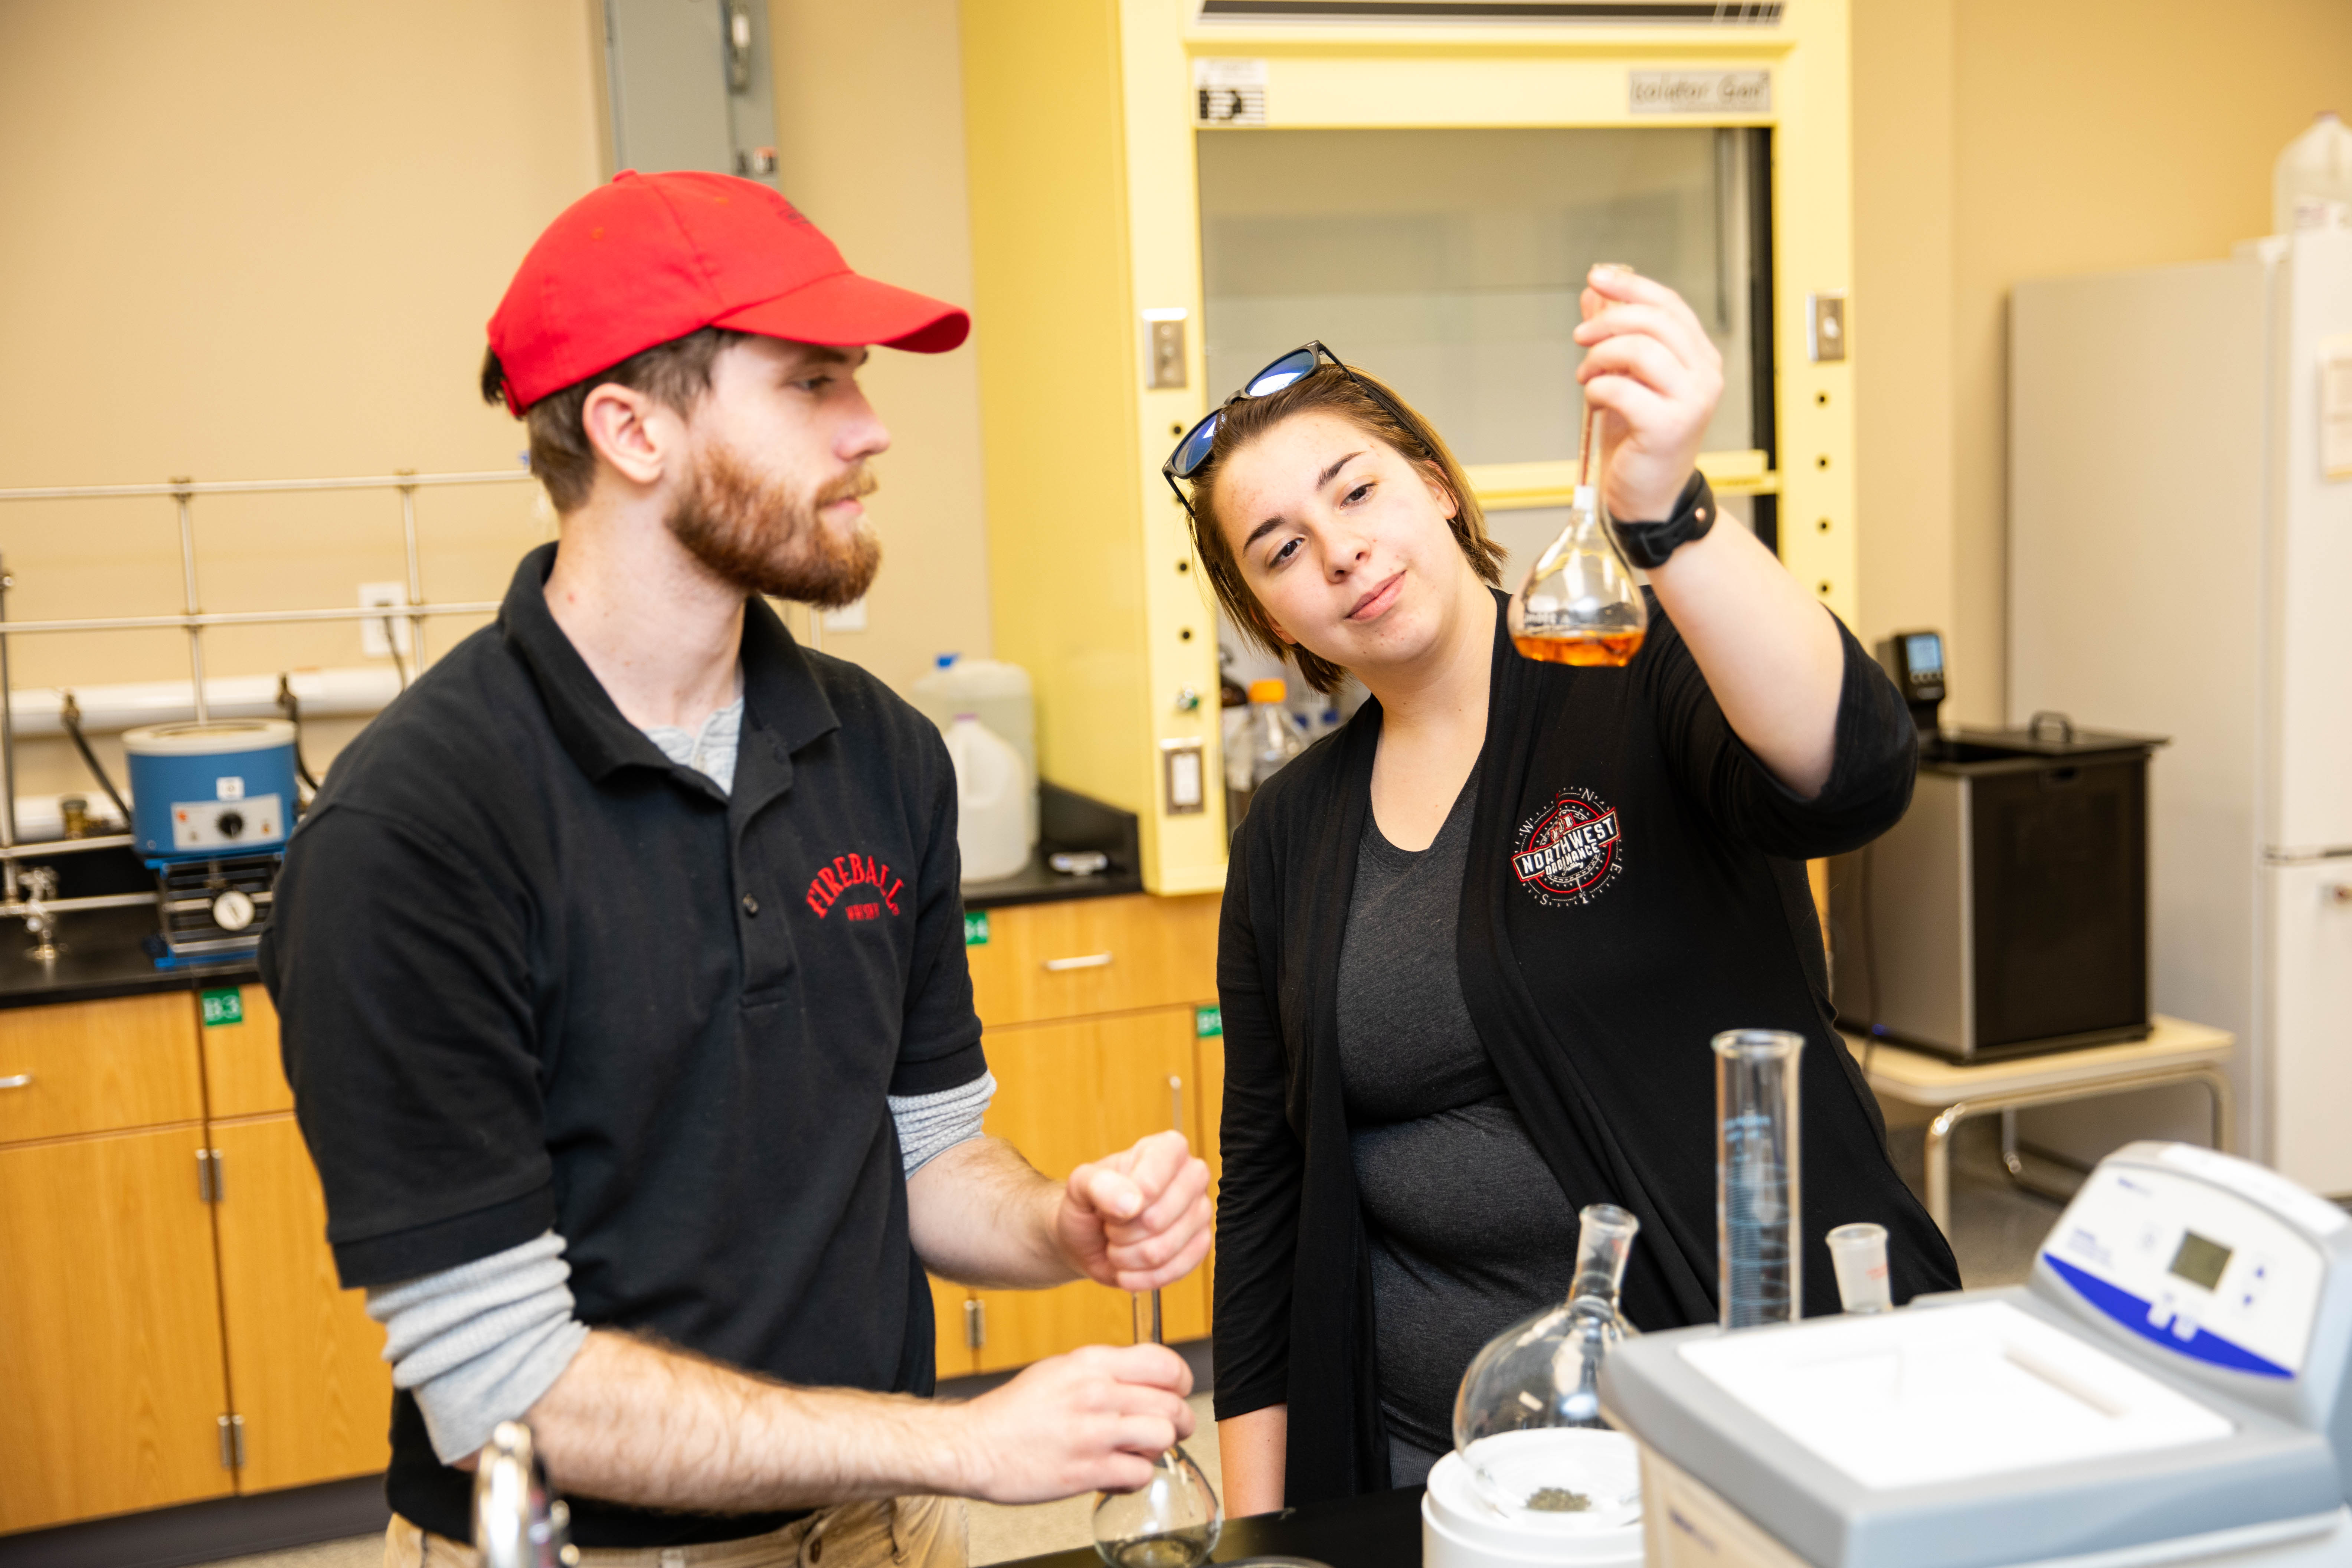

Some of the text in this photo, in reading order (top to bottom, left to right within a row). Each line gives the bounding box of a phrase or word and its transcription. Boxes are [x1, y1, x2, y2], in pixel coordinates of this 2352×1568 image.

[1521, 817, 1613, 874] NORTHWEST
[1544, 842, 1600, 875] ORDINANCE
[806, 853, 904, 919] FIREBALL
